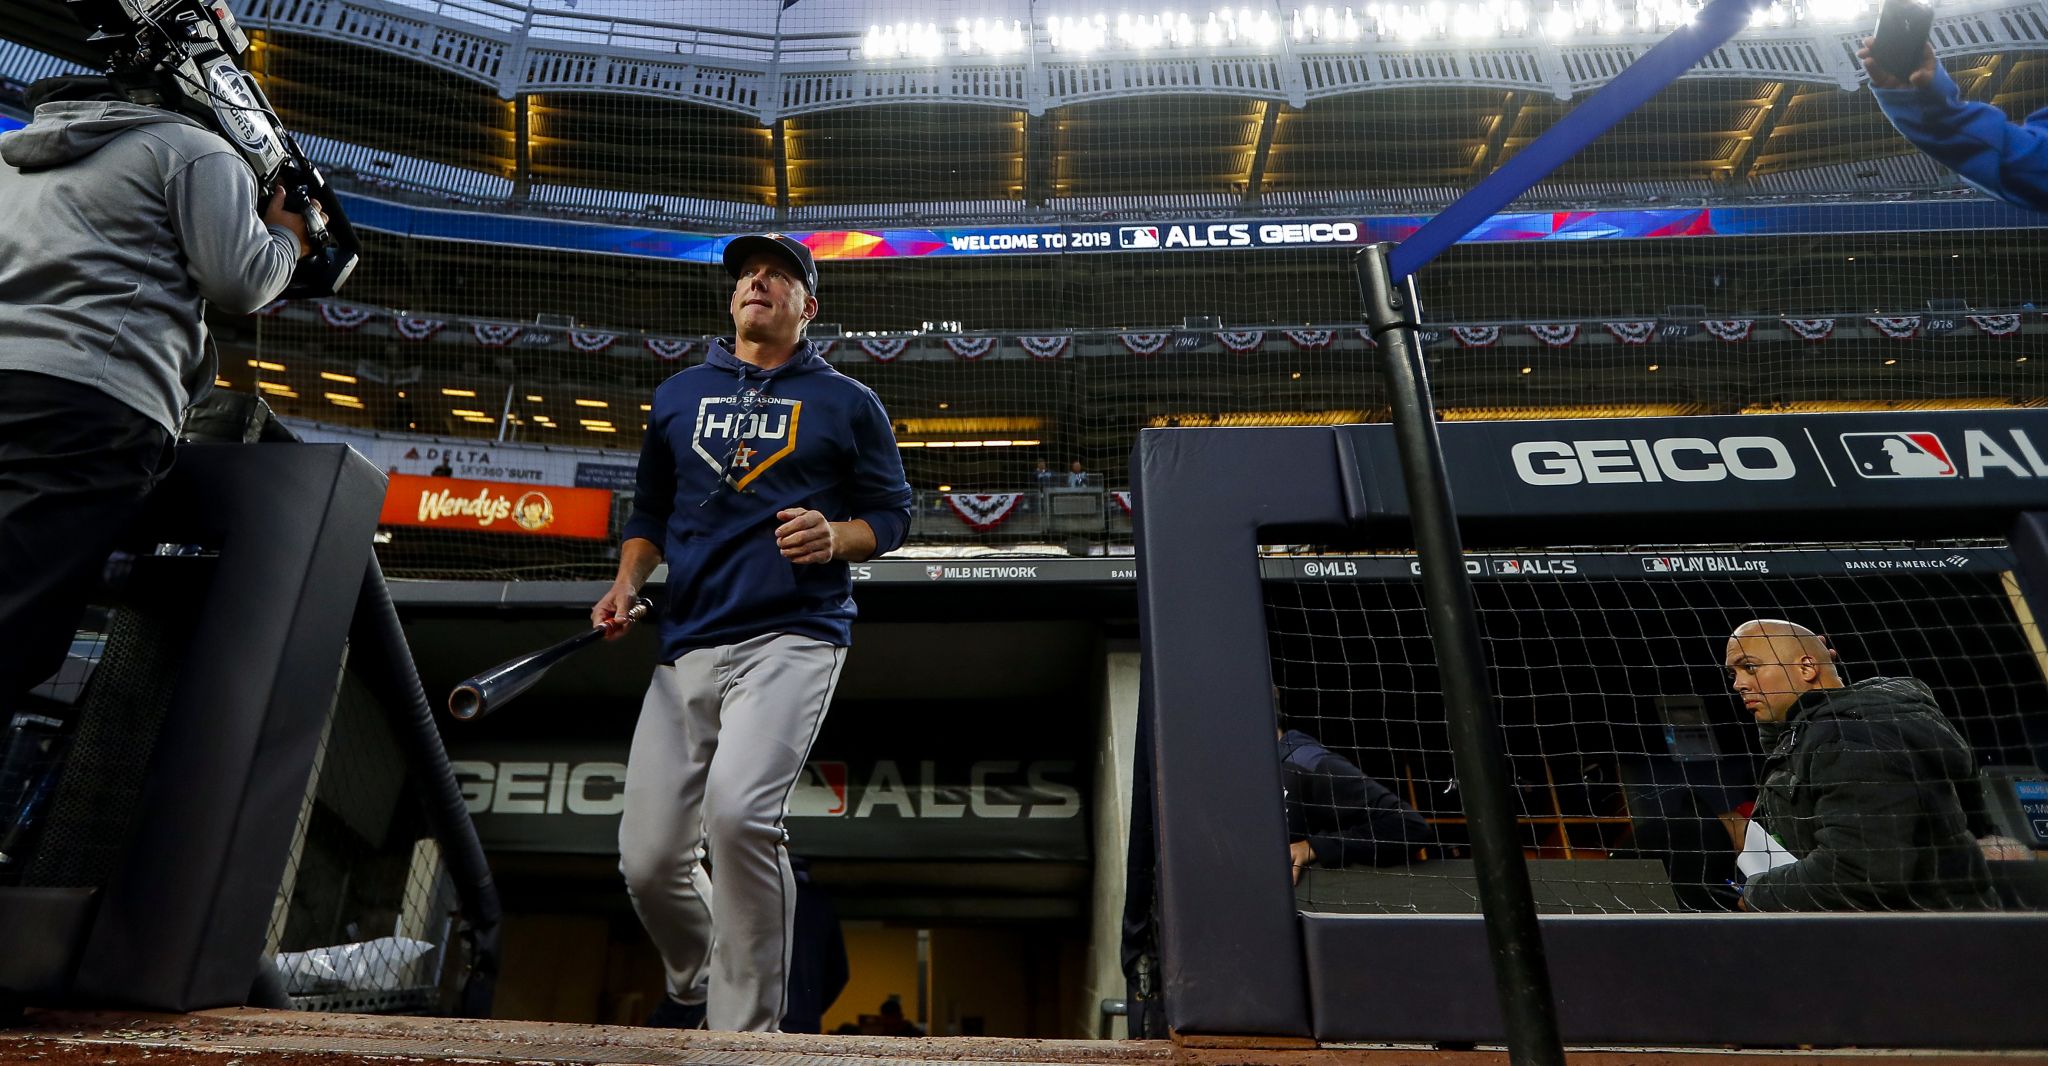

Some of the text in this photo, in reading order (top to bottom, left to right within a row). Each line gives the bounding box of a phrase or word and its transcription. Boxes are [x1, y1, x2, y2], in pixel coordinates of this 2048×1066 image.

[219, 90, 253, 140] SORTS
[951, 222, 1357, 250] WELCOME TO 2019 ALCS GEICO
[1662, 325, 1688, 335] 1977
[1927, 319, 1953, 329] 1978
[1418, 331, 1438, 341] 962
[704, 413, 787, 438] HOU
[427, 448, 490, 464] DELTA
[1511, 436, 1796, 485] GEICO
[418, 488, 511, 526] Wendy's
[1304, 562, 1357, 576] @MLB
[1521, 560, 1577, 574] ALCS
[1670, 557, 1704, 571] PLAY
[1845, 560, 1947, 569] BANK OF AMERICA
[944, 568, 971, 578] MLB
[973, 567, 1037, 577] NETWORK
[450, 761, 626, 815] GEIC
[854, 760, 1080, 818] ALCS
